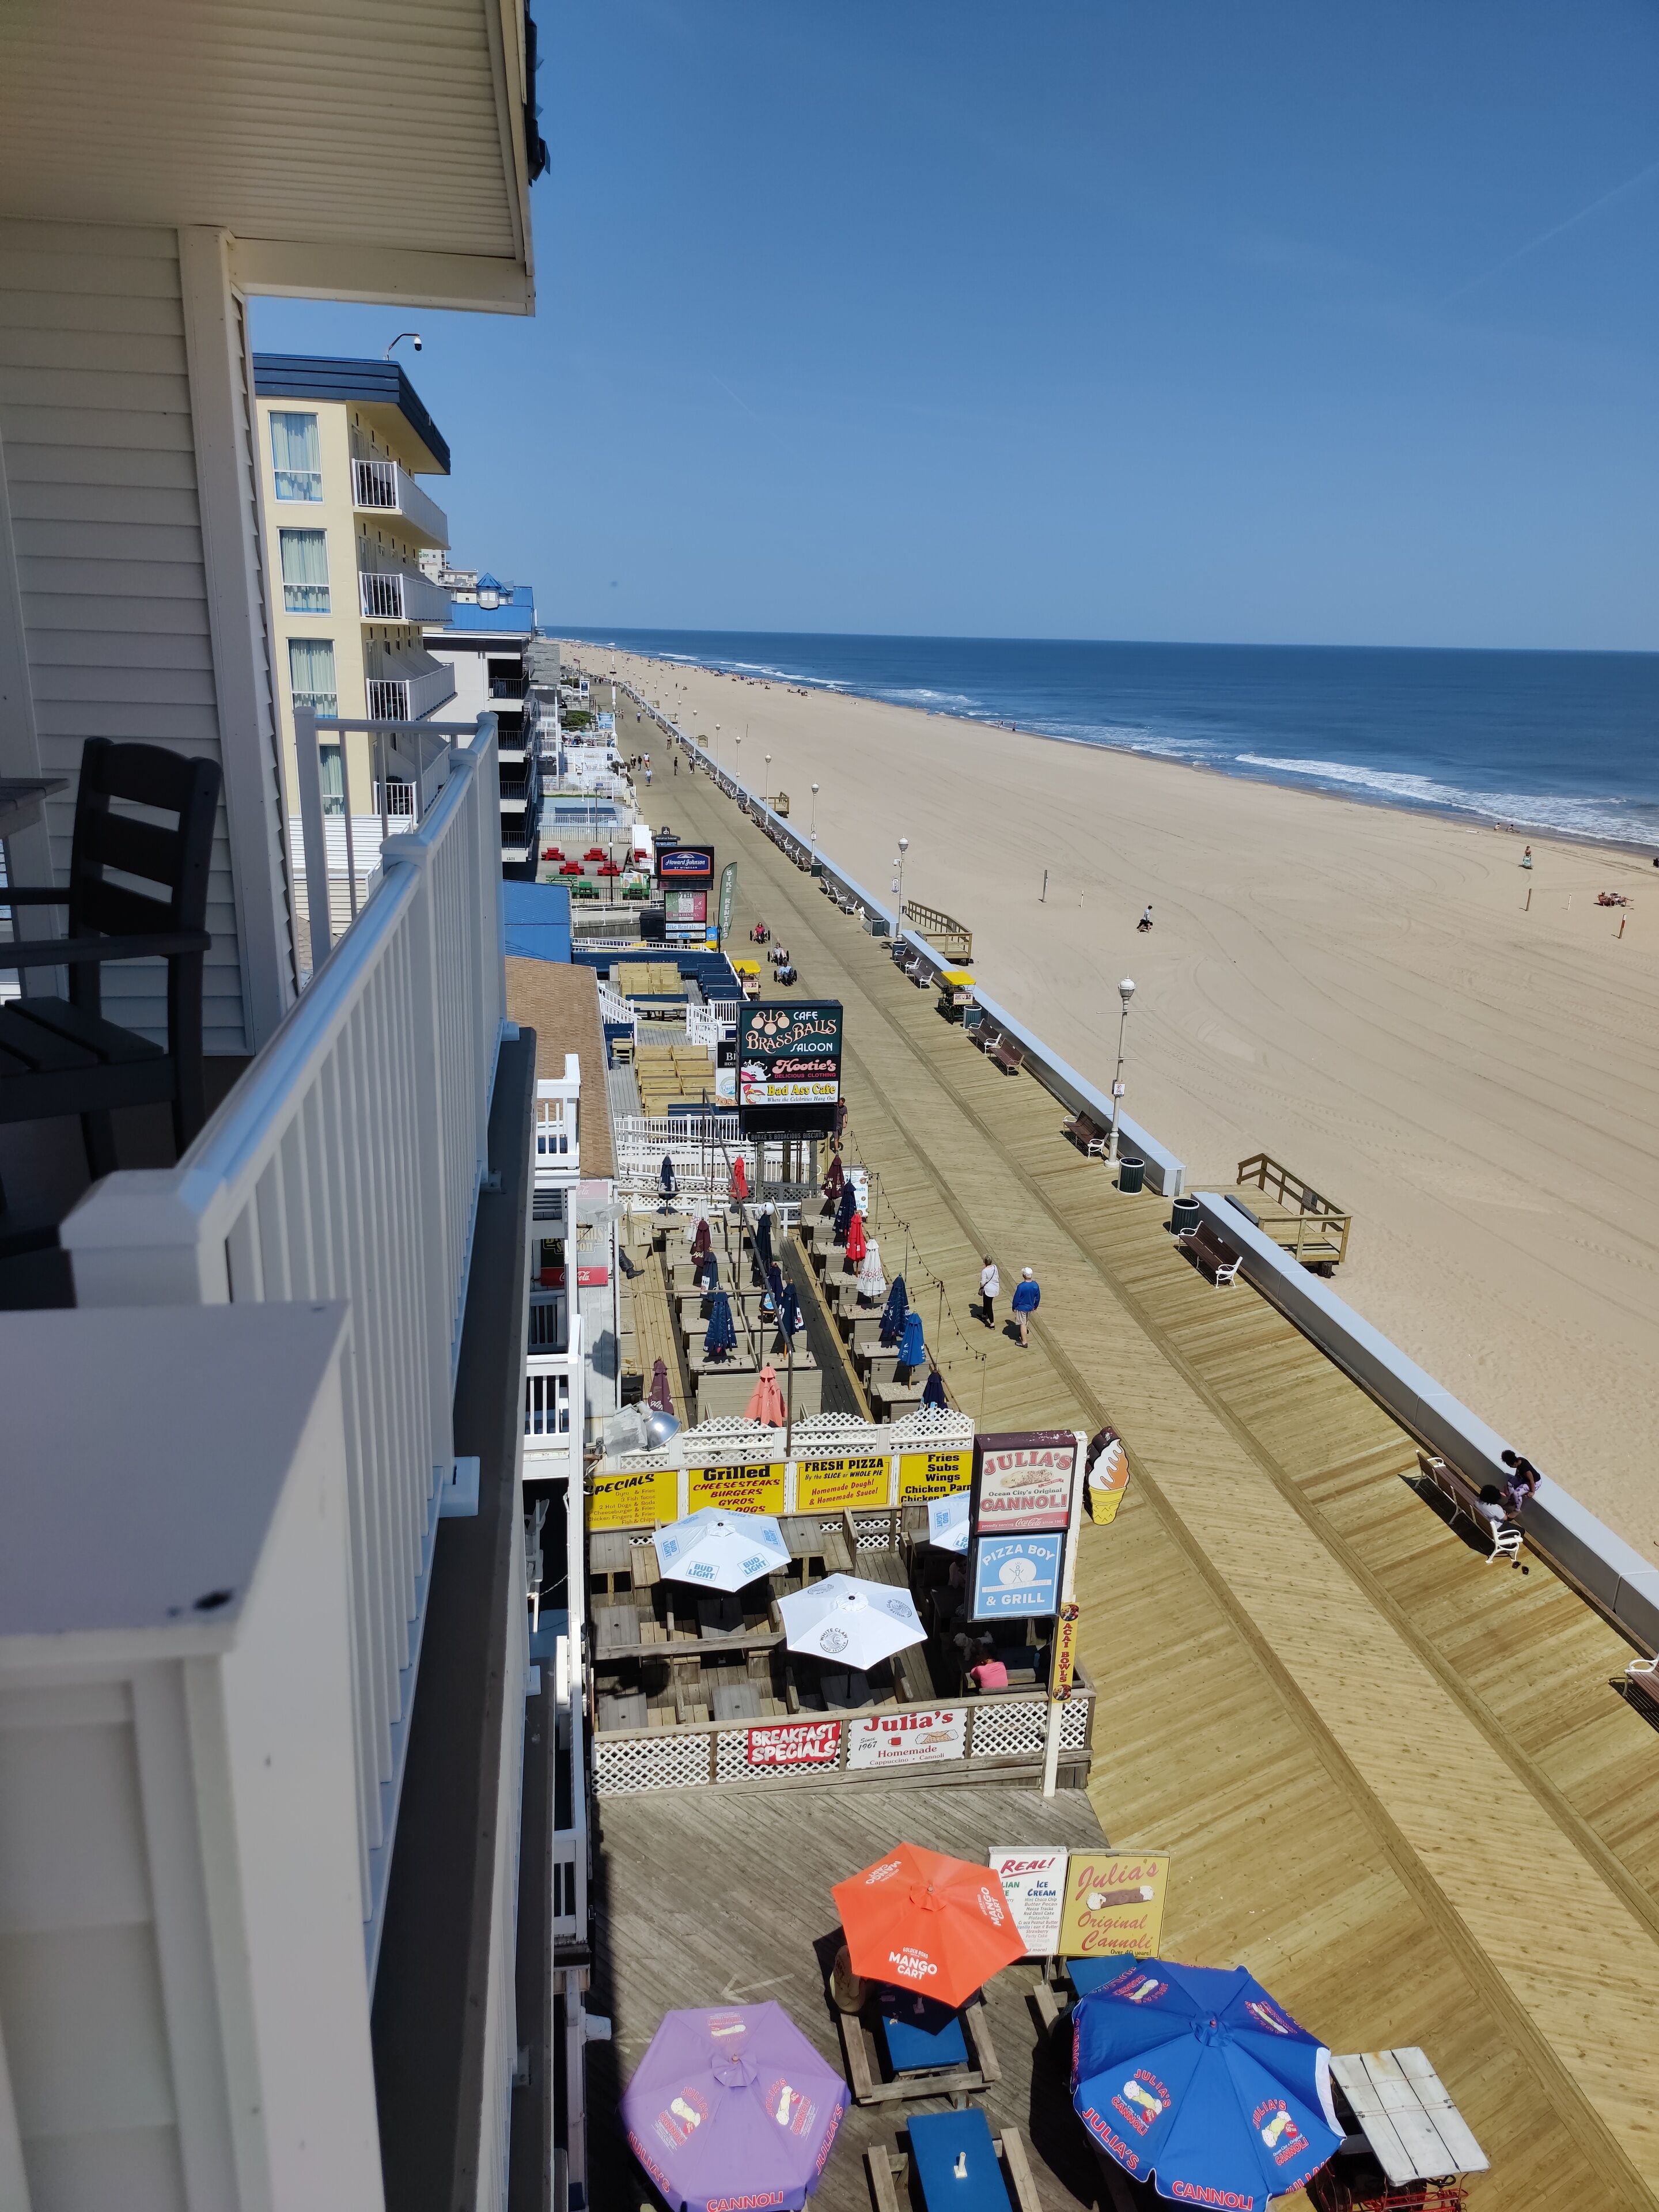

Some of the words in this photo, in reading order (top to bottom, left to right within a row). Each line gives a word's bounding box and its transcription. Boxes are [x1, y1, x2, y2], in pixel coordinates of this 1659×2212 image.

[722, 898, 731, 938] RENTALS
[793, 1011, 818, 1020] CAFE
[745, 1030, 793, 1054] BRASS
[792, 1019, 837, 1041] BALLS
[790, 1043, 833, 1052] SALOON
[772, 1058, 836, 1074] Hootie's
[767, 1084, 789, 1096] Bad
[791, 1084, 810, 1095] Ass
[812, 1083, 836, 1094] Cafe
[805, 1460, 844, 1472] FRESH
[849, 1458, 884, 1469] PIZZA
[927, 1453, 960, 1462] Fries
[984, 1450, 1073, 1475] JULIA'S
[703, 1465, 770, 1481] Grilled
[927, 1463, 959, 1472] Subs
[584, 1474, 654, 1496] SPECIALS
[693, 1479, 781, 1491] CHEESESTEAKS
[812, 1484, 849, 1495] Homemade
[851, 1479, 874, 1489] Dough!
[926, 1474, 960, 1483] Wings
[710, 1488, 763, 1498] BURGERS
[817, 1492, 854, 1504] Homemade
[856, 1487, 878, 1497] Sauce!
[905, 1485, 946, 1494] Chicken
[718, 1498, 755, 1506] GYROS
[734, 1505, 766, 1513] DOGS
[980, 1494, 1067, 1512] CANNOLI
[770, 1529, 778, 1544] LIGHT
[662, 1541, 672, 1558] LIGHT
[669, 1539, 677, 1553] BUD
[743, 1557, 760, 1568] BUD
[982, 1544, 1023, 1566] PIZZA
[1028, 1544, 1055, 1561] BOY
[688, 1569, 715, 1579] LIGHT
[694, 1563, 713, 1573] BUD
[744, 1560, 766, 1575] LIGHT
[986, 1596, 995, 1606] &
[1001, 1593, 1045, 1605] GRILL
[820, 1628, 834, 1641] WHITE
[835, 1628, 848, 1638] CLAW
[1062, 1623, 1073, 1648] ACAI
[1058, 1652, 1070, 1683] BOWLS
[863, 1710, 953, 1732] Julia's
[752, 1723, 836, 1746] BREAKFAST
[752, 1740, 836, 1762] SPECIALS
[858, 1741, 877, 1751] 1967
[878, 1745, 937, 1758] Homemade
[870, 1758, 908, 1766] Cappuccino
[865, 1861, 902, 1884] MANGO
[1001, 1857, 1056, 1873] REAL!
[1075, 1858, 1159, 1901] Julia's
[1027, 1888, 1056, 1896] CREAM
[980, 1887, 1002, 1926] MANGO
[991, 1897, 1005, 1919] CART
[1078, 1911, 1148, 1934] Original
[1081, 1930, 1153, 1951] Cannoli
[889, 1951, 938, 1975] MANGO
[918, 1950, 929, 1959] ROAD
[897, 1965, 925, 1980] CART
[1134, 2069, 1171, 2108] JULIA'S
[681, 2086, 709, 2120] JULIA'S
[766, 2078, 787, 2118] JULIA'S
[793, 2096, 811, 2135] CANNOLI
[1111, 2096, 1148, 2137] CANNOLI
[1252, 2099, 1287, 2130] JULIA'S
[659, 2111, 686, 2147] CANNOLI
[816, 2103, 844, 2176] JULIA'S
[1082, 2107, 1139, 2170] JULIA'S
[1275, 2137, 1309, 2166] CANNOLI
[707, 2191, 783, 2212] CANNOLI
[1172, 2180, 1253, 2211] CANNOLI
